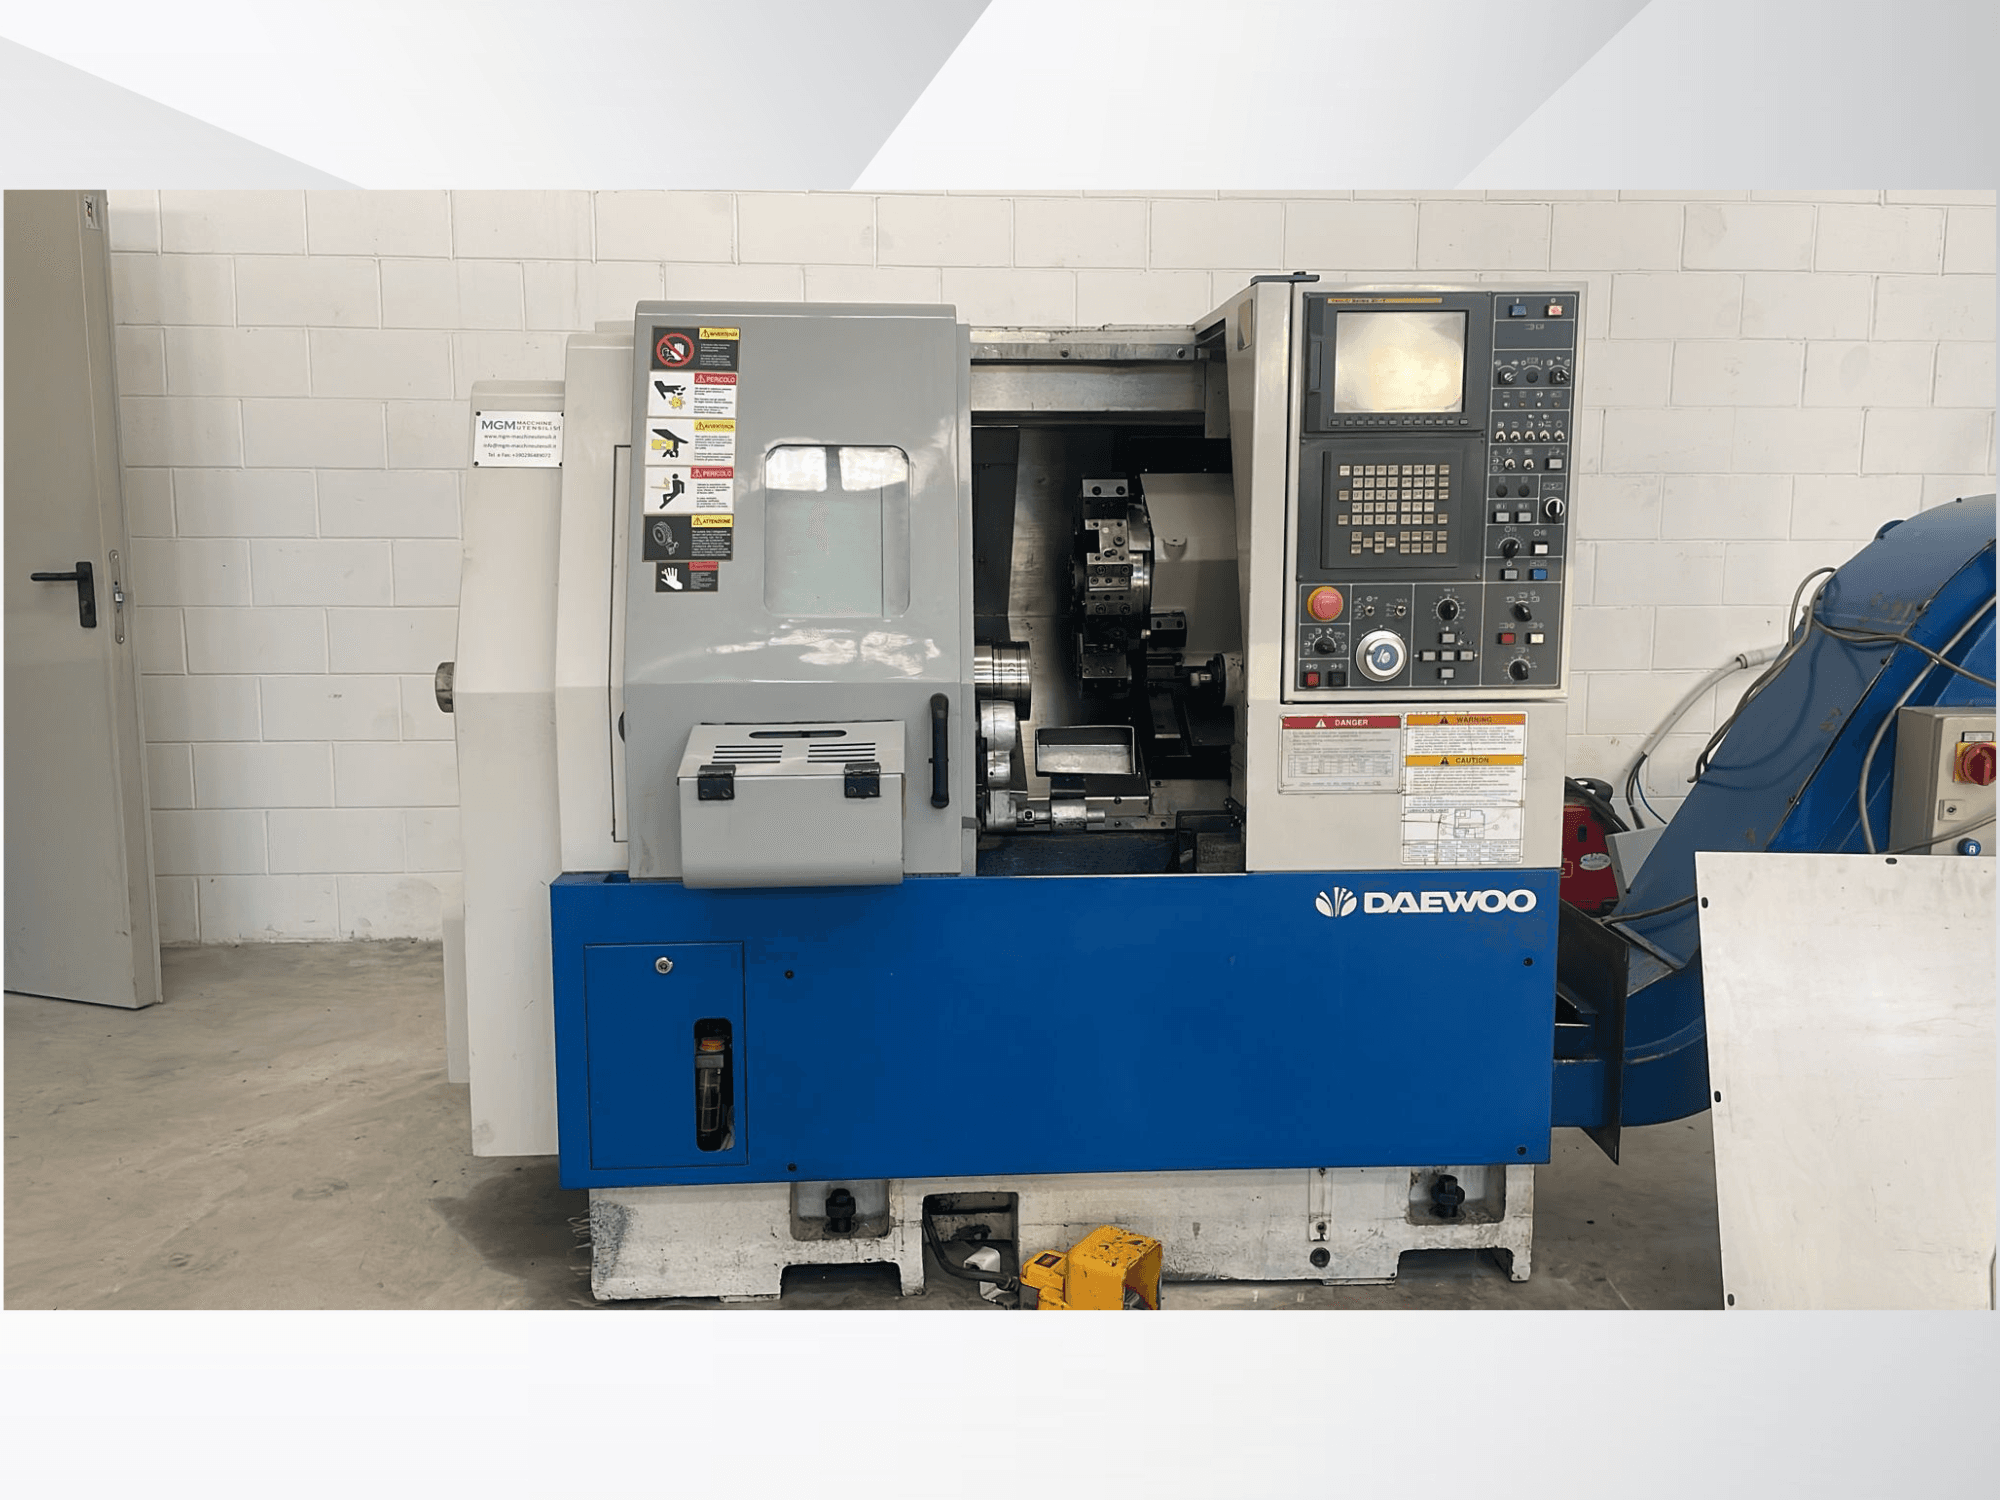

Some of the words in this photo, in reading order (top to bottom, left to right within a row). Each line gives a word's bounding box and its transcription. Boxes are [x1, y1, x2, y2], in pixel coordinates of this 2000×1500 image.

[481, 420, 516, 430] MGM
[1334, 718, 1369, 726] DANGER
[1968, 845, 1976, 853] R
[1363, 888, 1538, 914] DAEWOO
